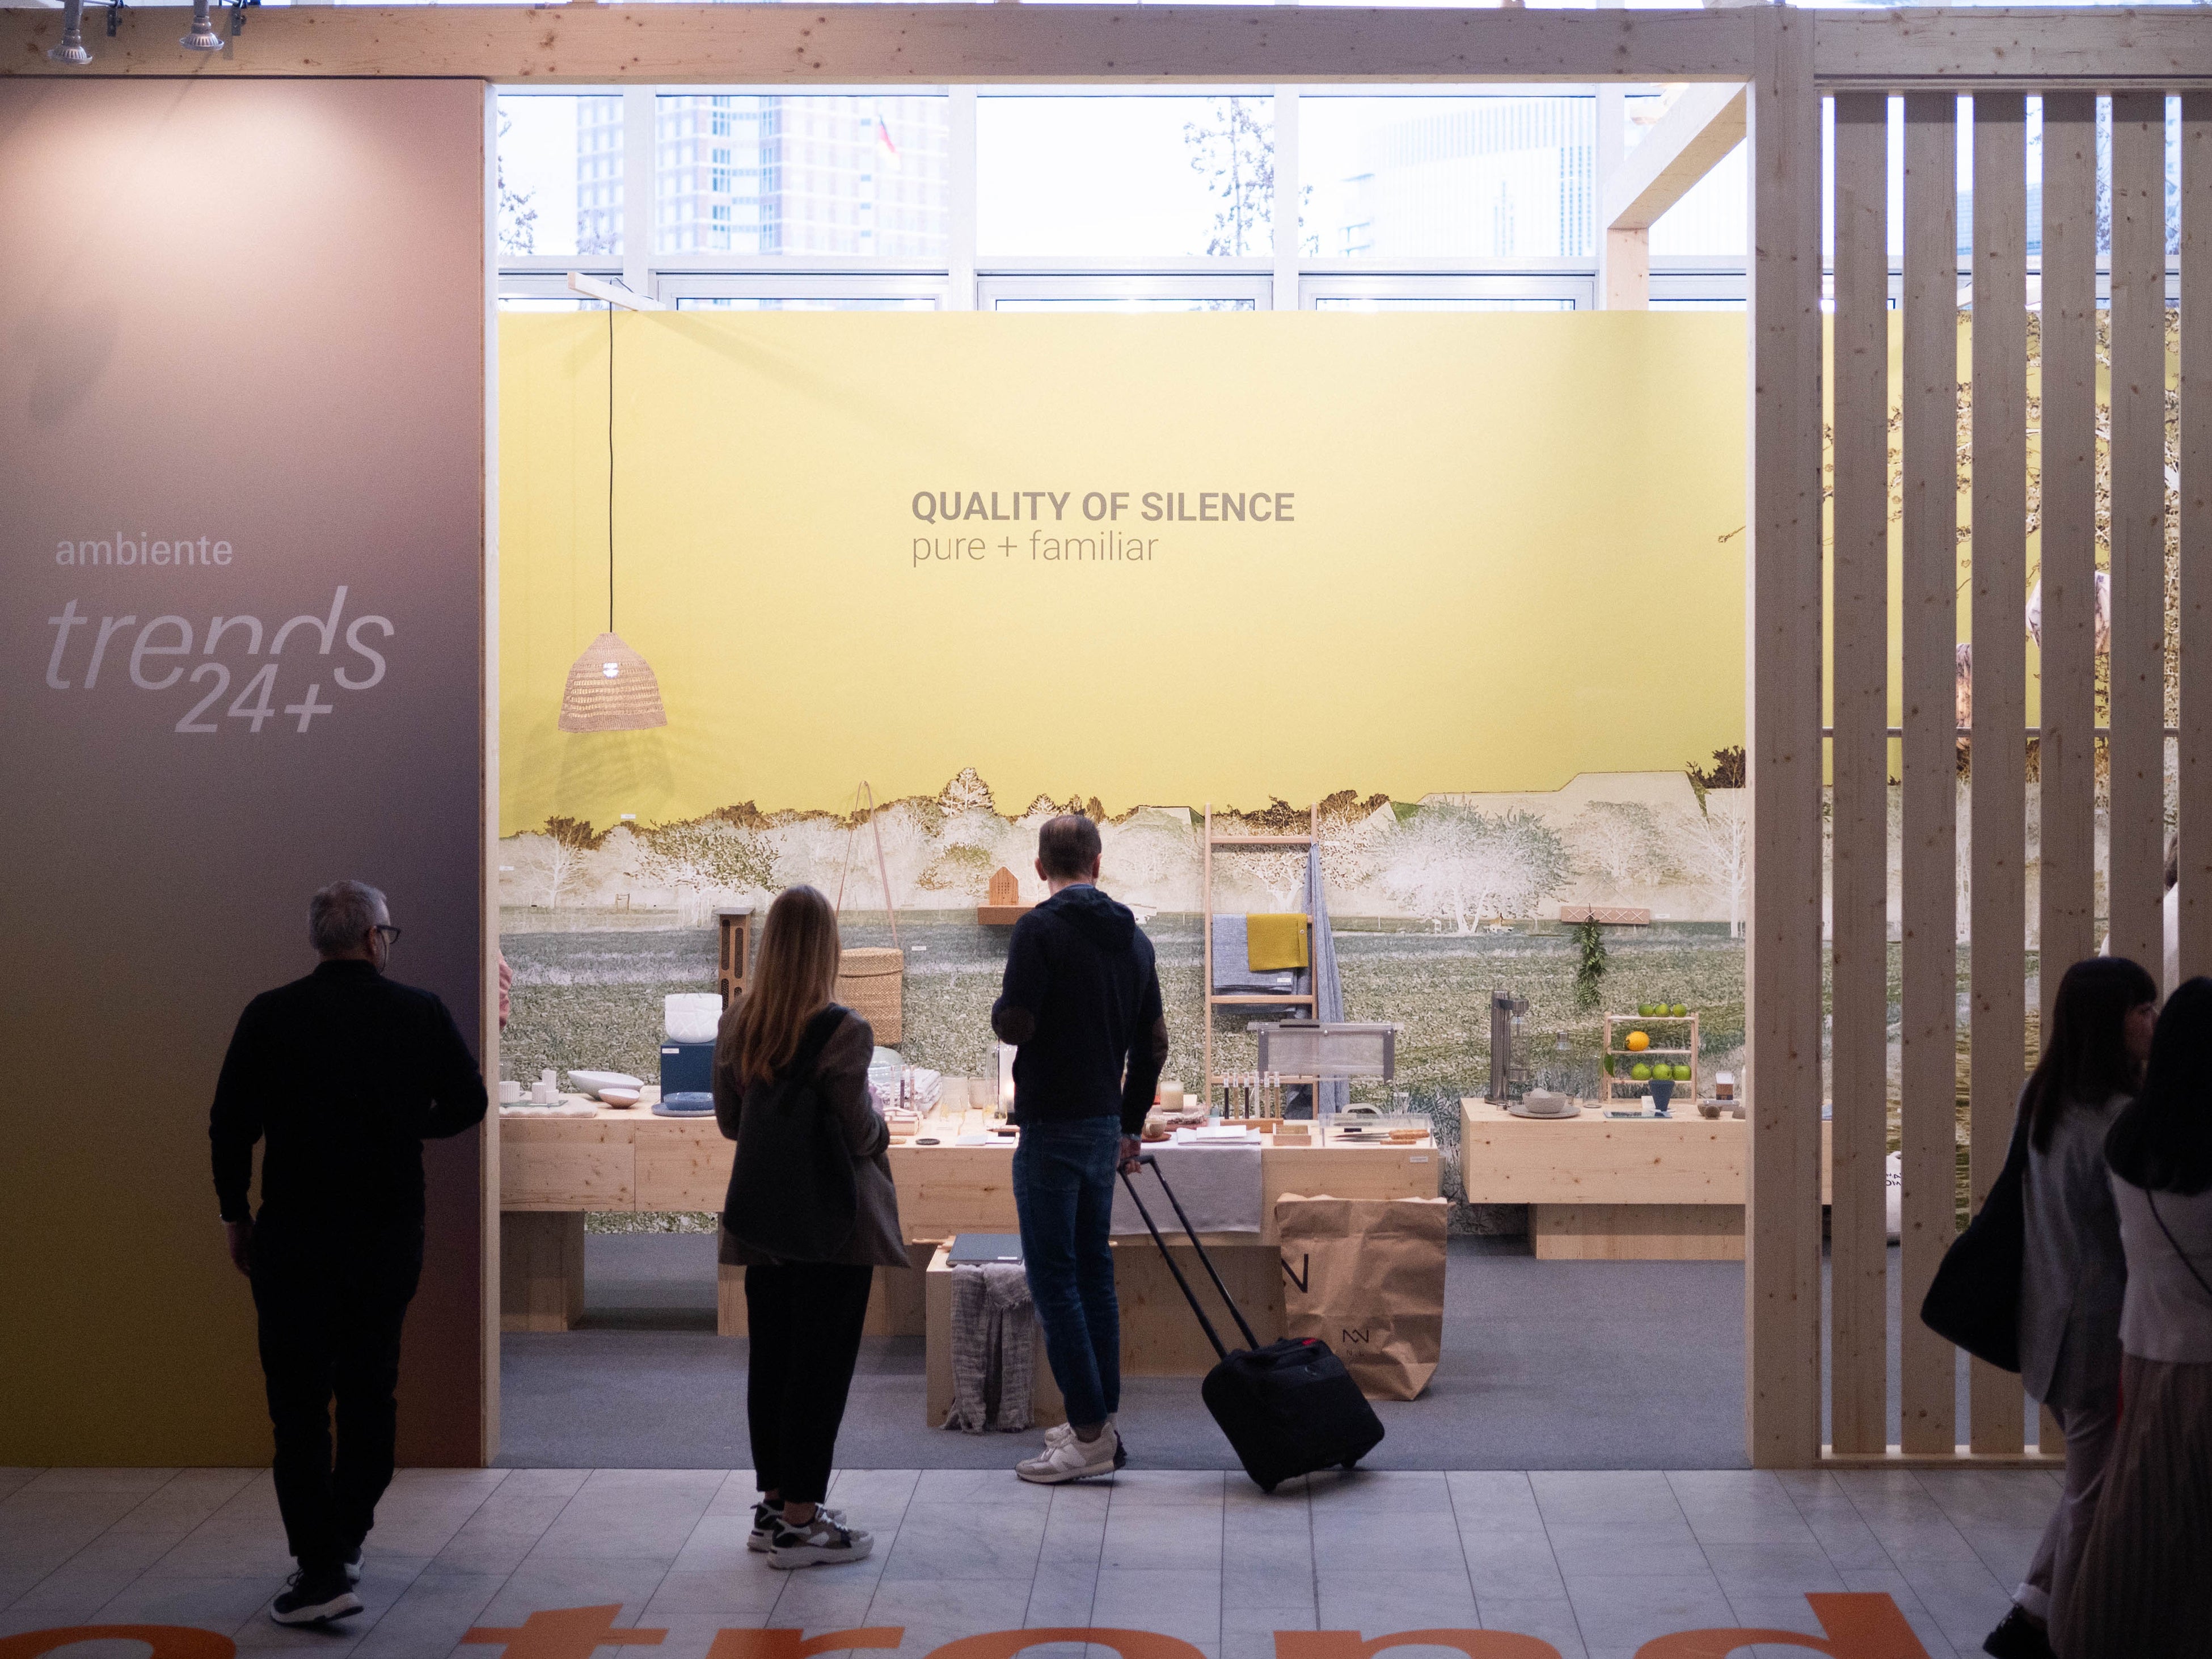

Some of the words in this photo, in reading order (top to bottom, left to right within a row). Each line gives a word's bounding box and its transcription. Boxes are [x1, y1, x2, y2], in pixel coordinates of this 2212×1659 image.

[911, 491, 1071, 526] QUALITY
[1081, 491, 1130, 522] OF
[1140, 491, 1296, 523] SILENCE
[54, 531, 234, 566] ambiente
[912, 537, 987, 569] pure
[996, 535, 1019, 559] +
[1028, 529, 1160, 562] familiar
[45, 584, 396, 691] trends
[174, 662, 334, 733] 24+
